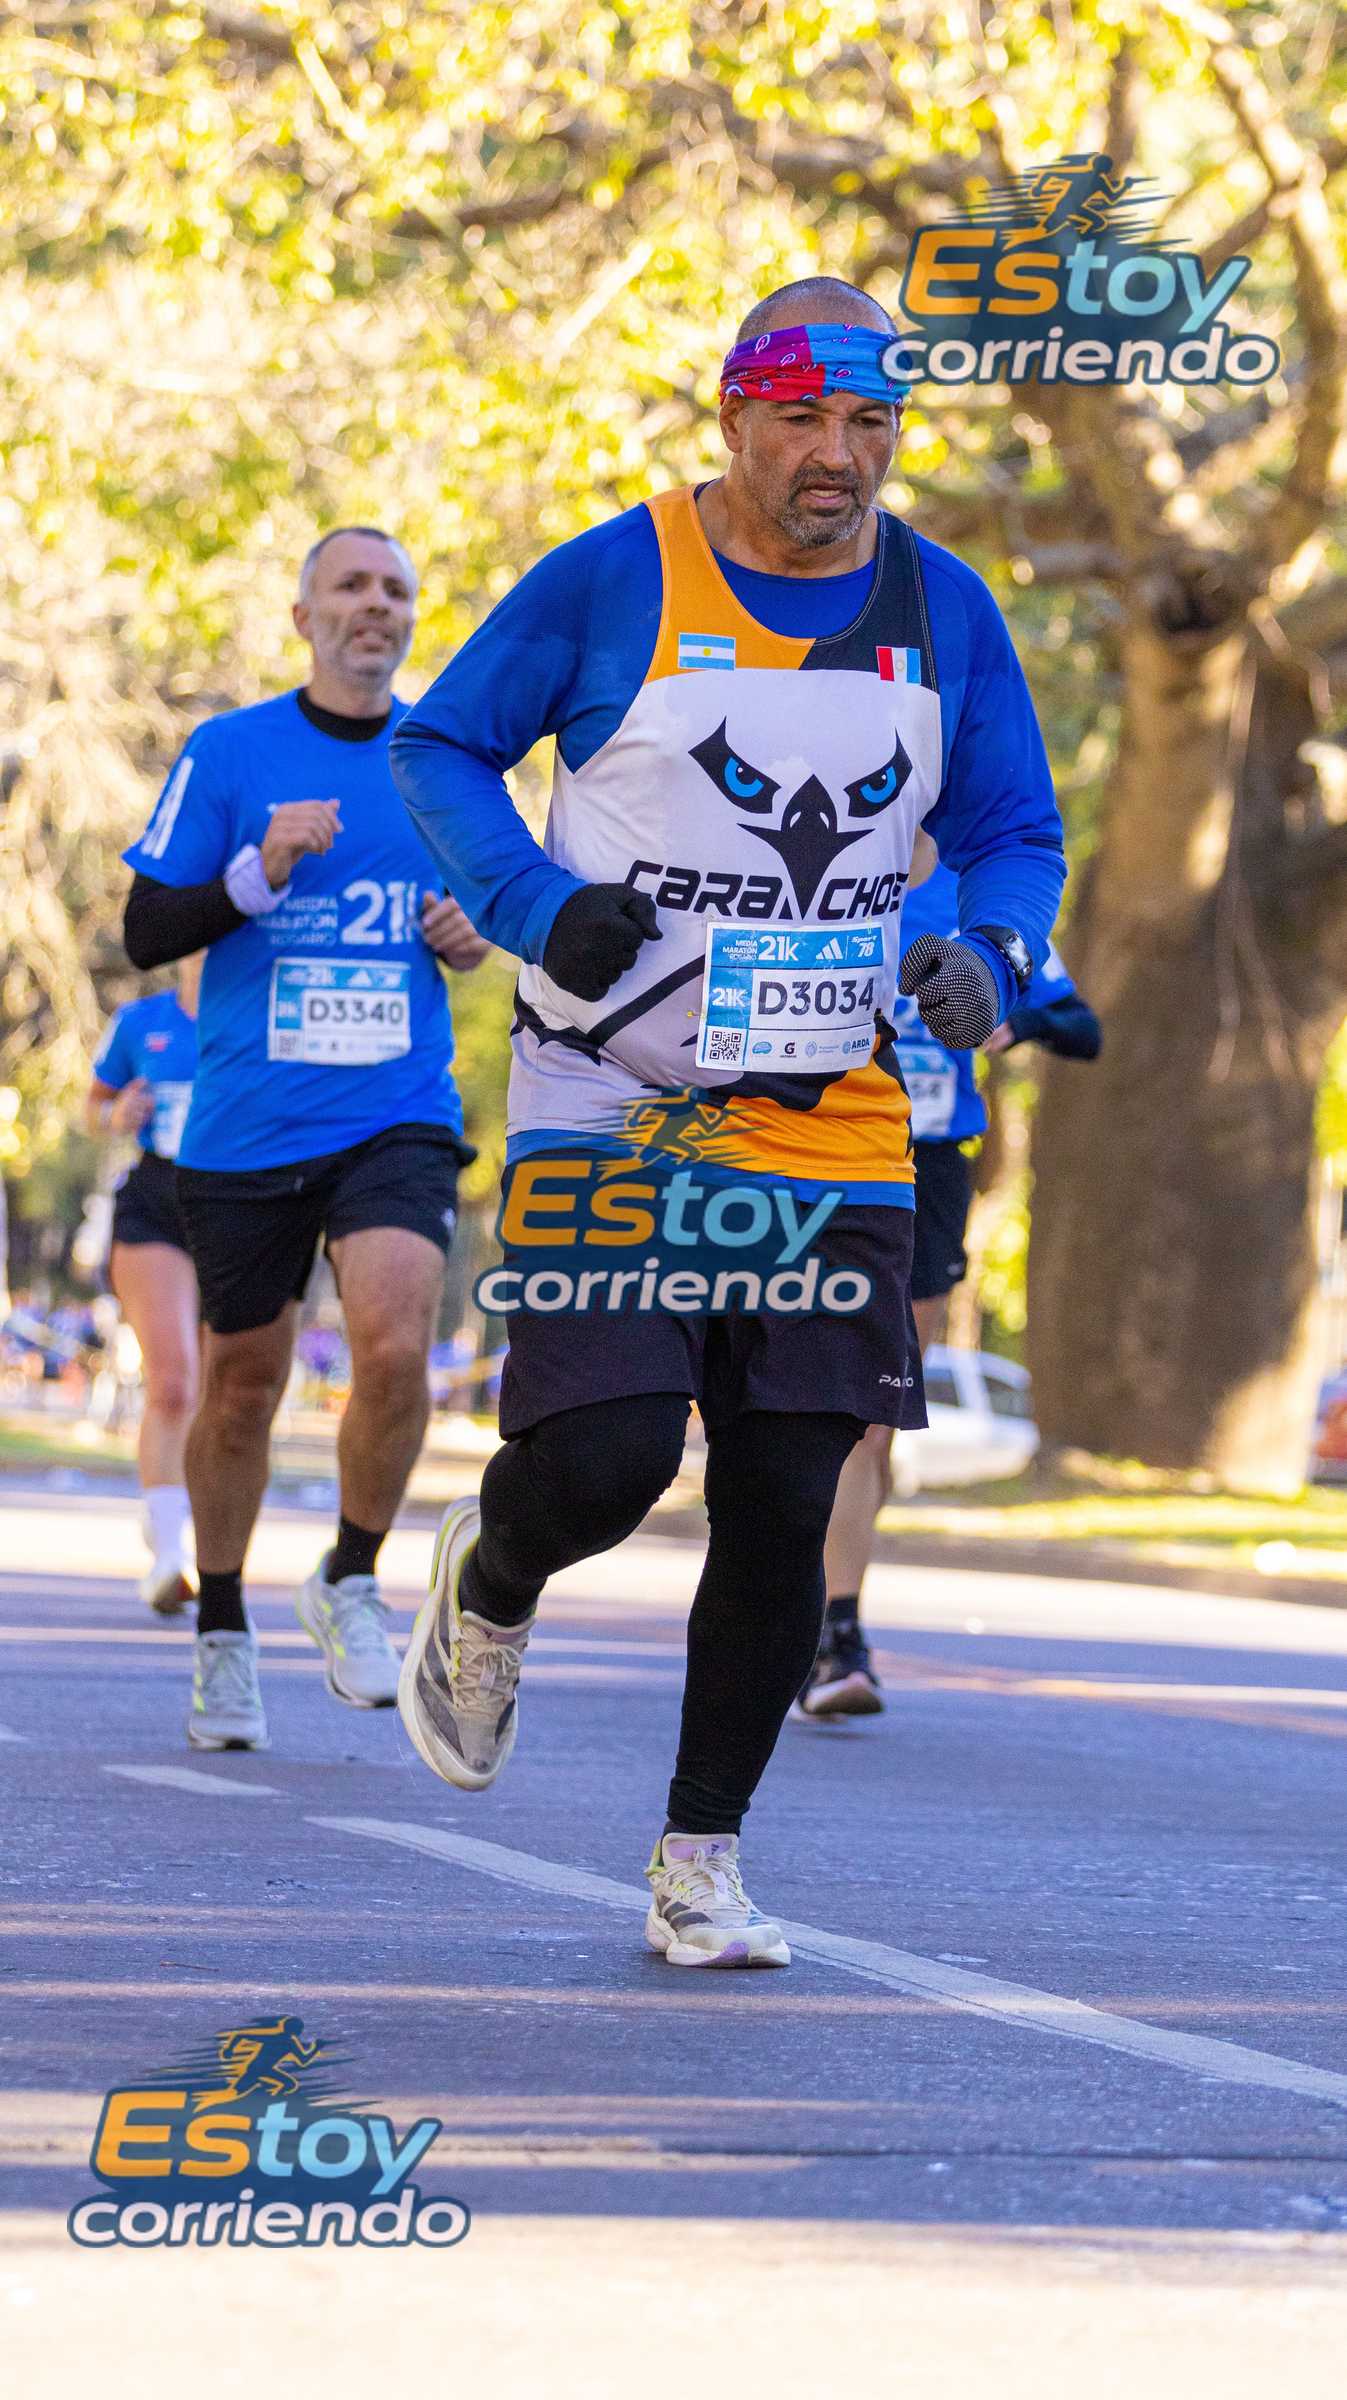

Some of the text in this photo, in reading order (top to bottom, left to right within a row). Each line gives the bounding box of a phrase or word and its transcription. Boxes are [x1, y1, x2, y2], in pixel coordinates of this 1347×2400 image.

[309, 997, 404, 1025] D3340
[757, 977, 875, 1017] D3034
[851, 1038, 870, 1049] ARDA
